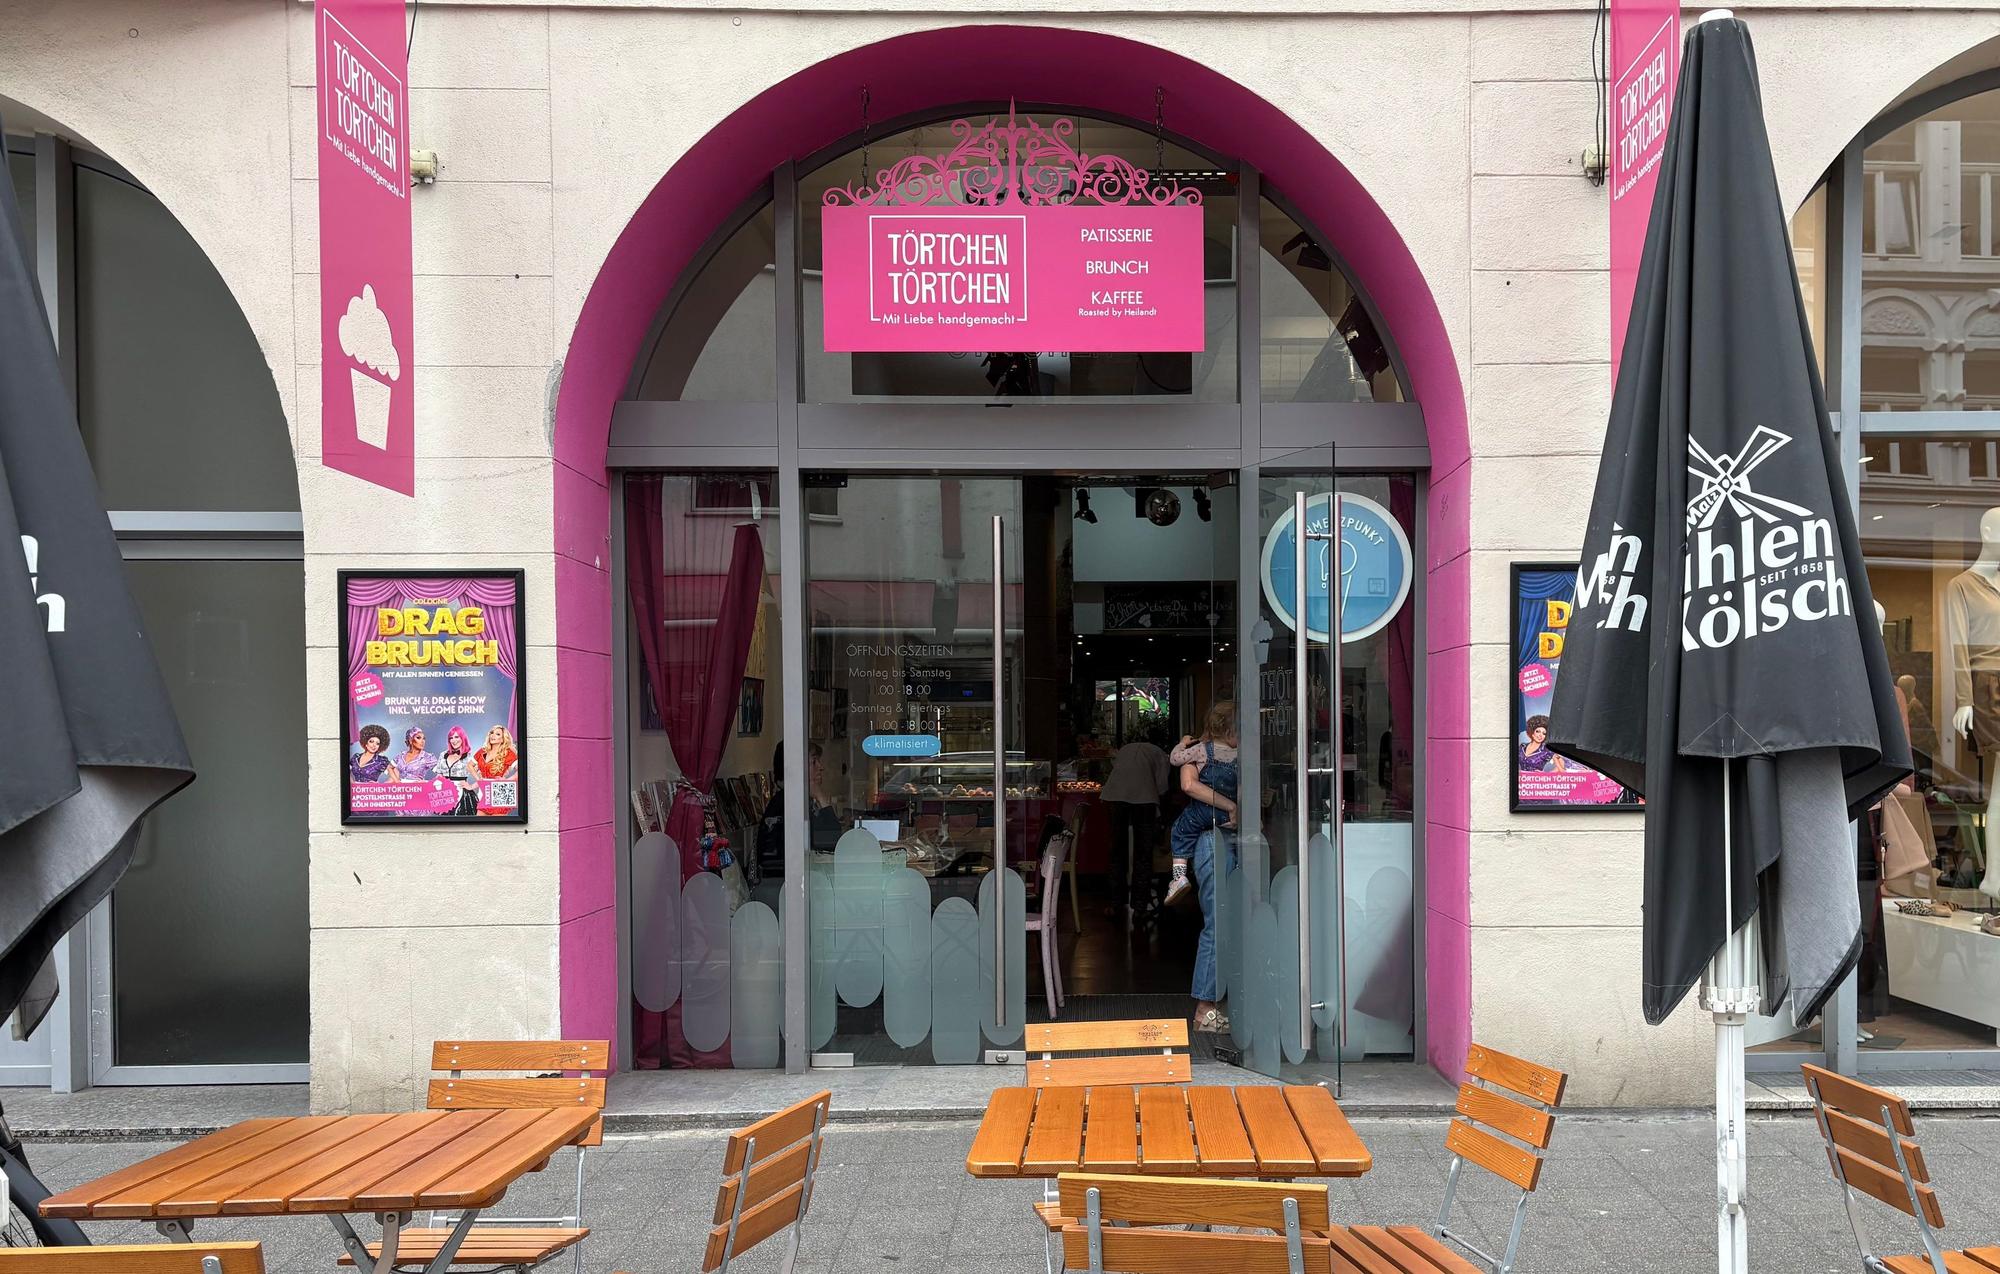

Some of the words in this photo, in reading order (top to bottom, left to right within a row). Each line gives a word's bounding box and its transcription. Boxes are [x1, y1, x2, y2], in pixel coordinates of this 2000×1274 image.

[333, 40, 395, 128] TÖRTCHEN
[1620, 48, 1666, 130] TÖRTCHEN
[335, 87, 396, 172] TÖRTCHEN
[1620, 92, 1666, 173] TÖRTCHEN
[333, 136, 343, 152] Mit
[344, 143, 361, 167] Liebe
[361, 155, 399, 197] handgemacht
[1625, 174, 1637, 192] Liebe
[1080, 228, 1154, 243] PATISSERIE
[887, 229, 1008, 266] TÖRTCHEN
[1085, 260, 1149, 275] BRUNCH
[887, 268, 1010, 305] TÖRTCHEN
[1090, 291, 1144, 306] KAFFEE
[882, 312, 901, 325] Mit
[903, 312, 934, 325] Liebe
[937, 312, 1015, 328] handgemacht
[1077, 308, 1111, 317] Roasted
[1112, 308, 1123, 319] by
[1123, 307, 1157, 317] Heilandt
[1687, 491, 1719, 526] Malz
[1760, 569, 1788, 587] SEIT
[1793, 561, 1824, 577] 1858
[376, 606, 485, 637] DRAG
[366, 639, 500, 668] BRUNCH
[846, 644, 953, 656] ÖFFNUNGSZEITEN
[418, 670, 444, 678] SINNEN
[445, 670, 484, 678] GENIESSEN
[848, 667, 888, 680] Montag
[892, 667, 906, 678] bis
[910, 667, 952, 680] Samstag
[1522, 674, 1545, 685] TICKETS
[354, 683, 378, 694] TICKETS
[384, 697, 421, 706] BRUNCH
[423, 697, 430, 705] &
[432, 697, 457, 705] DRAG
[459, 696, 486, 705] SHOW
[388, 706, 410, 714] INKL.
[412, 706, 456, 714] WELCOME
[457, 705, 485, 714] DRINK
[851, 703, 892, 716] Sonntag
[895, 702, 904, 713] &
[906, 720, 936, 731] 1800
[874, 737, 928, 748] klimatisiert
[1553, 774, 1586, 782] TÖRTCHEN
[352, 785, 386, 793] TÖRTCHEN
[388, 785, 422, 793] TÖRTCHEN
[352, 800, 369, 808] KÖLN
